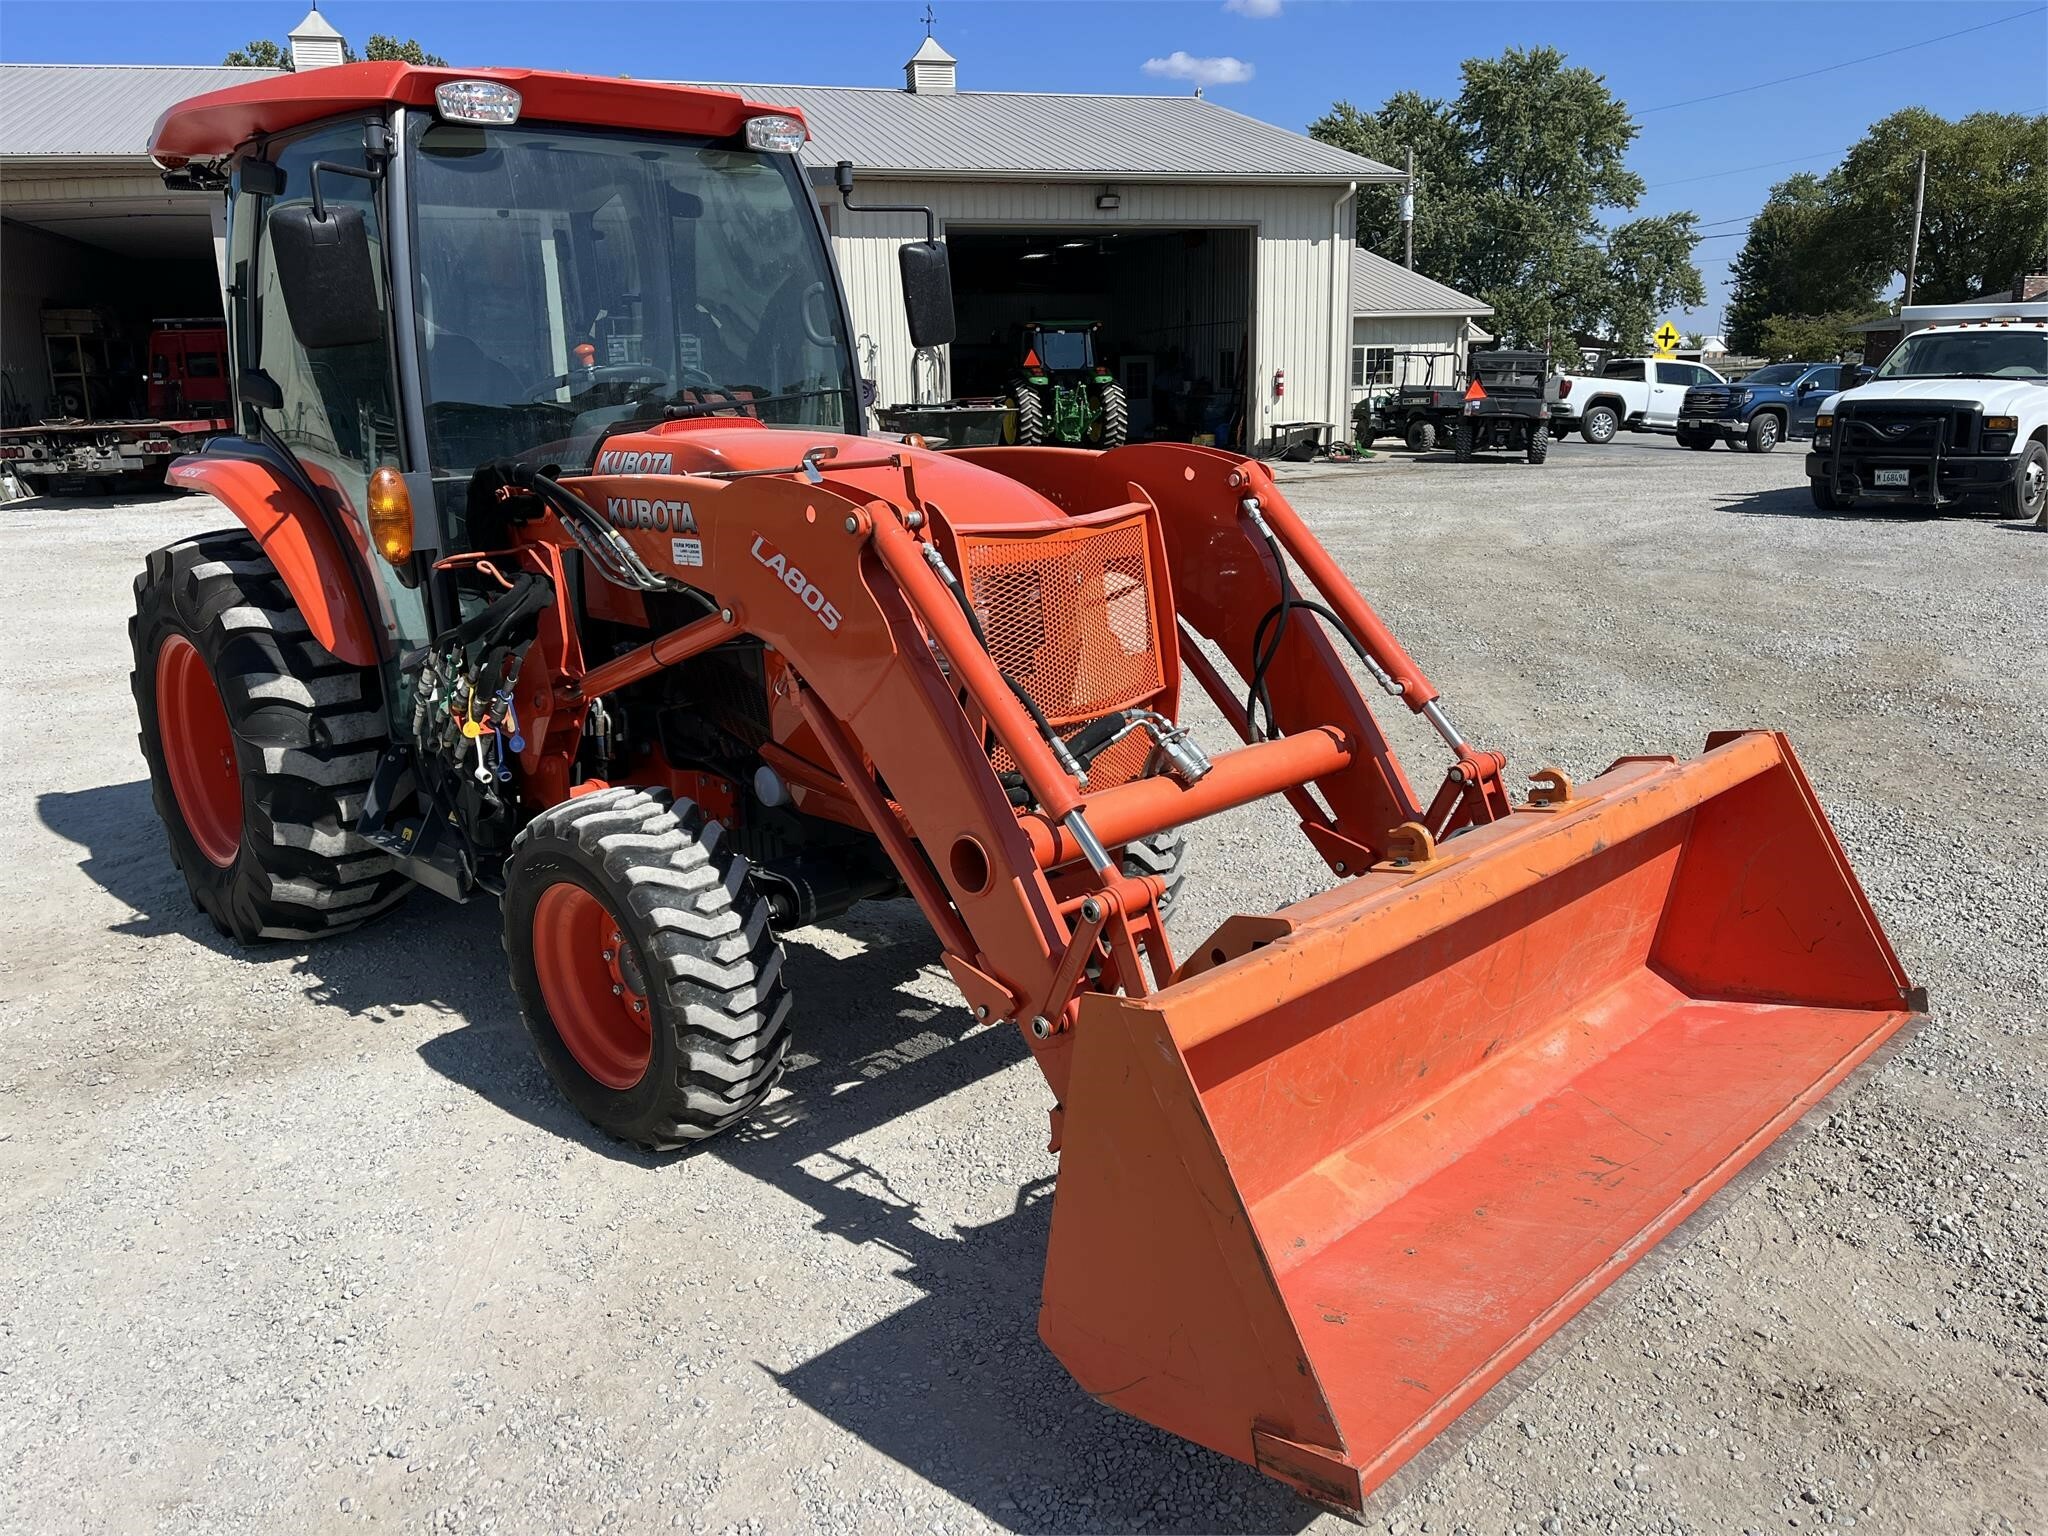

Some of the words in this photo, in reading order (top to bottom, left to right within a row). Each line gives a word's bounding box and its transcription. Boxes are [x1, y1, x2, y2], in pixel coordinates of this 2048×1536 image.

[597, 450, 673, 474] KUBOTA
[607, 497, 698, 534] KUBOTA
[751, 536, 842, 631] LA805
